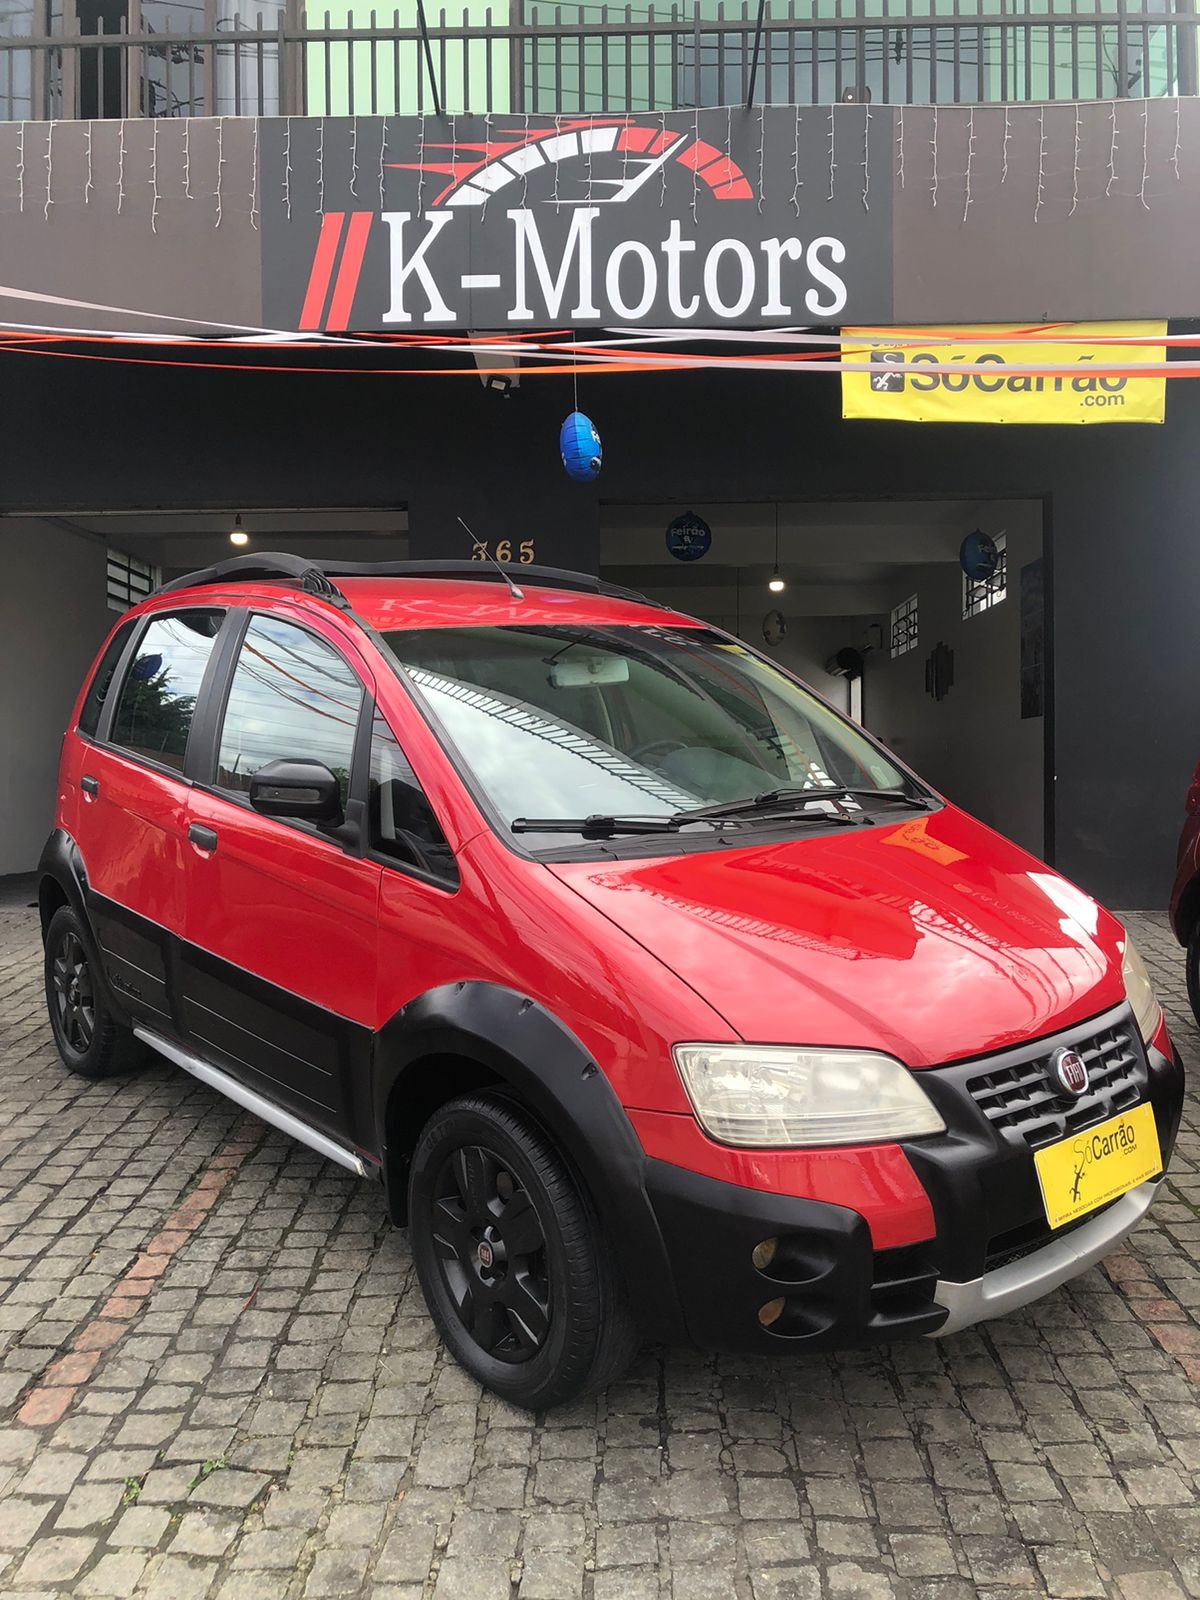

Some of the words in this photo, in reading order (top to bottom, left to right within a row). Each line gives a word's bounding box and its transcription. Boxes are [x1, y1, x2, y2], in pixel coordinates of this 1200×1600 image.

[381, 206, 848, 323] K-Motors
[1080, 394, 1125, 407] .com
[471, 538, 535, 565] 365
[1073, 1121, 1135, 1166] SóCarrão
